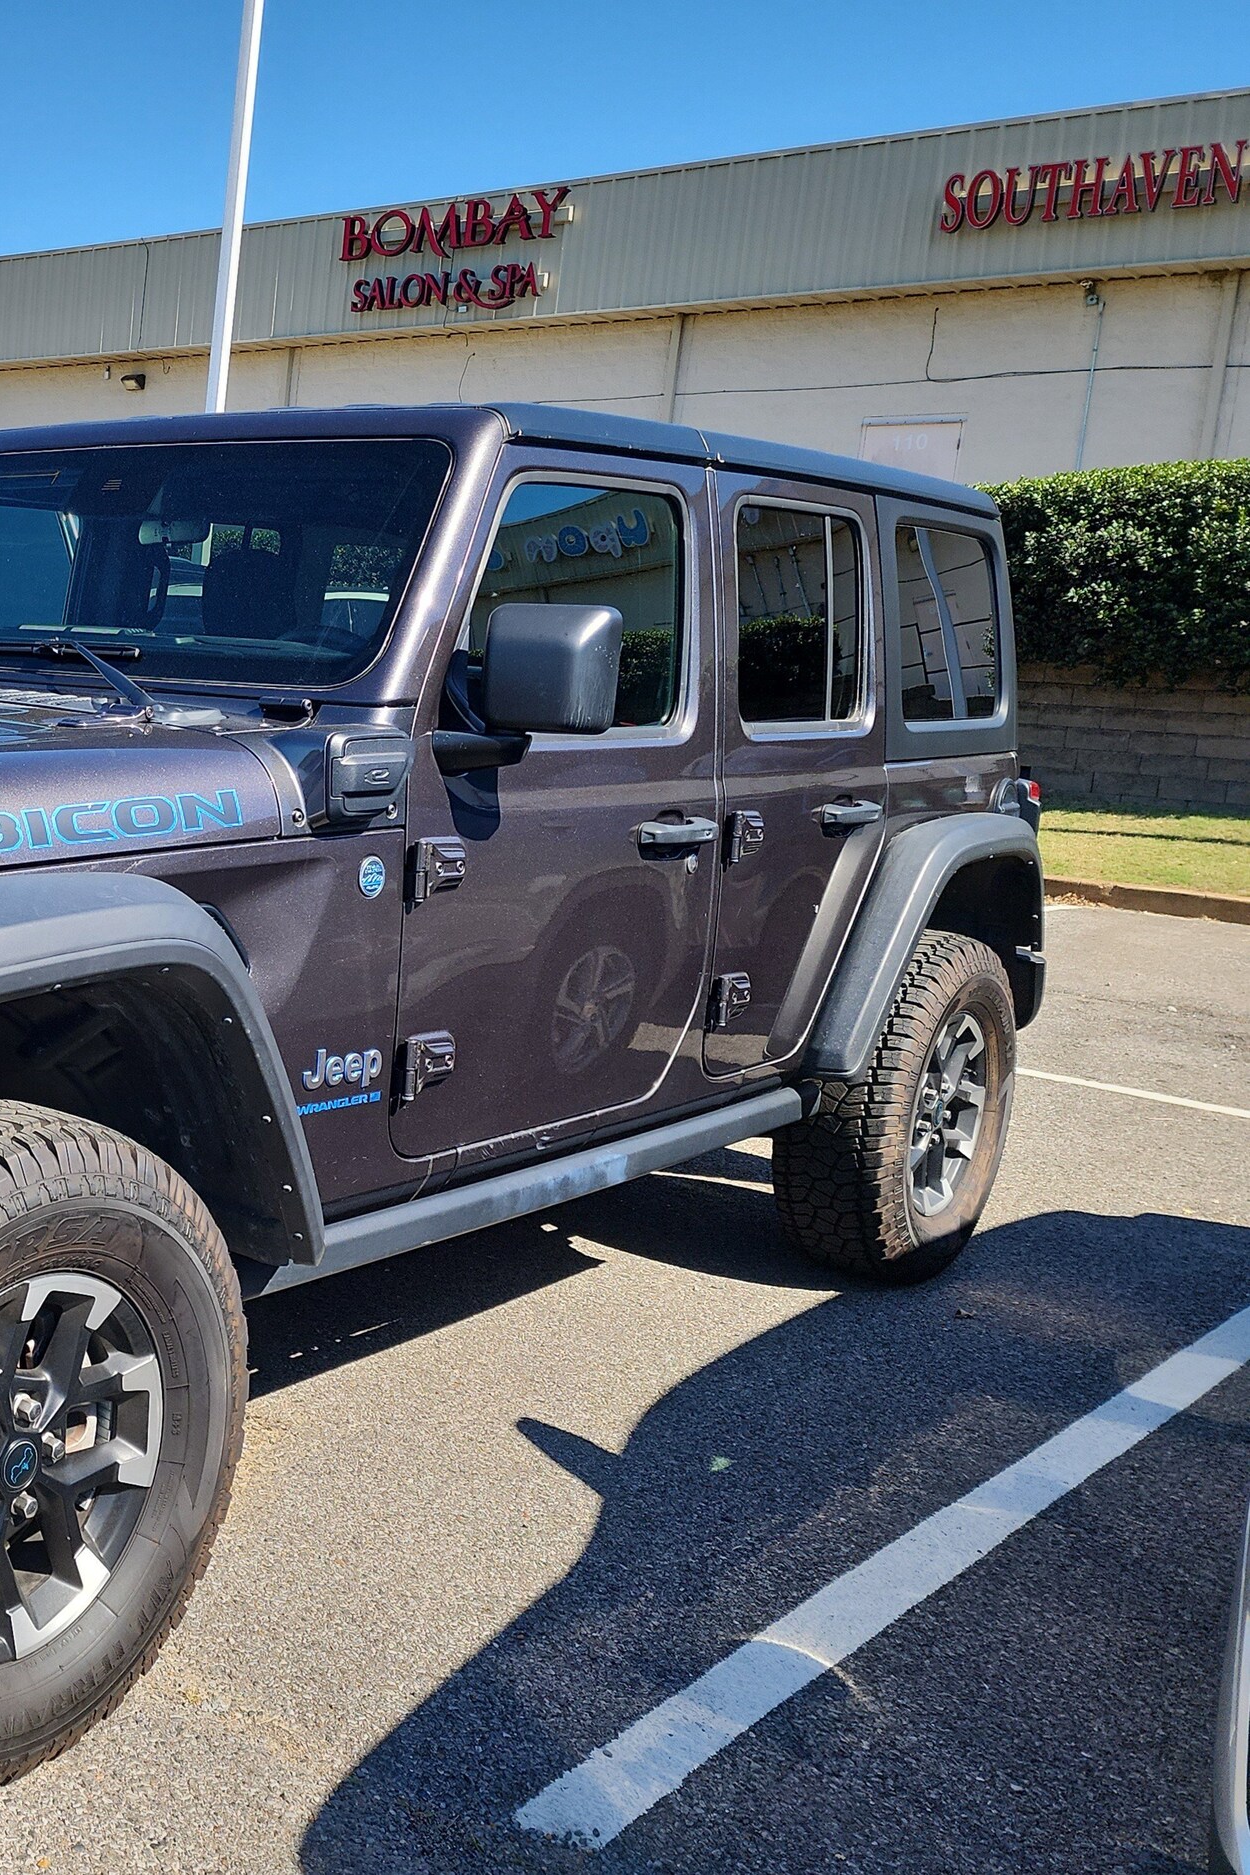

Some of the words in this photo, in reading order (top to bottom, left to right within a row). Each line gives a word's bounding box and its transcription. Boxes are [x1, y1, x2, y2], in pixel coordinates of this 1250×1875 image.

[940, 140, 1250, 233] SOUTHAVEN
[339, 187, 572, 261] BOMBAY
[351, 271, 451, 312] SALON
[453, 268, 516, 309] &
[488, 261, 542, 301] SPA
[893, 433, 928, 451] 110
[302, 1048, 383, 1090] Jeep
[296, 1093, 369, 1116] WRANGLER
